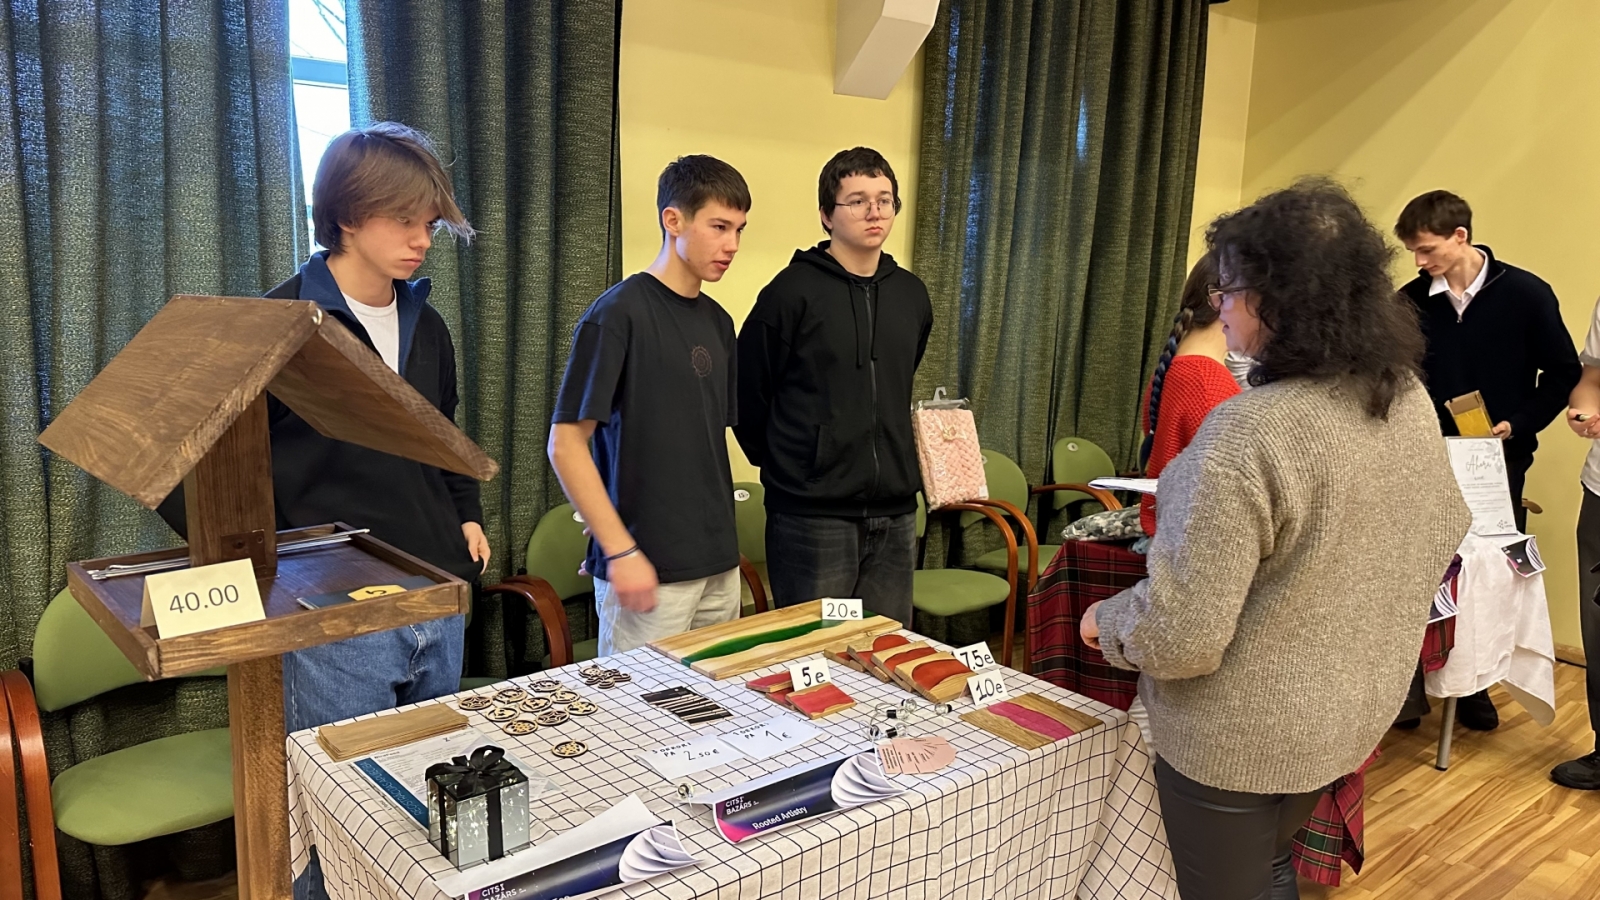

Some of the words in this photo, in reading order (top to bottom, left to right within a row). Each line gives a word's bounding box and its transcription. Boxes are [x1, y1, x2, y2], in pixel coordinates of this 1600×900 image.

[169, 584, 240, 614] 40.00
[826, 602, 859, 618] 20e
[960, 649, 994, 670] 7.5e
[975, 677, 1003, 701] 10e
[726, 801, 752, 815] BAZĀRS
[752, 815, 782, 830] Rooted
[781, 806, 808, 820] Artistry
[484, 888, 517, 900] AZĀRS
